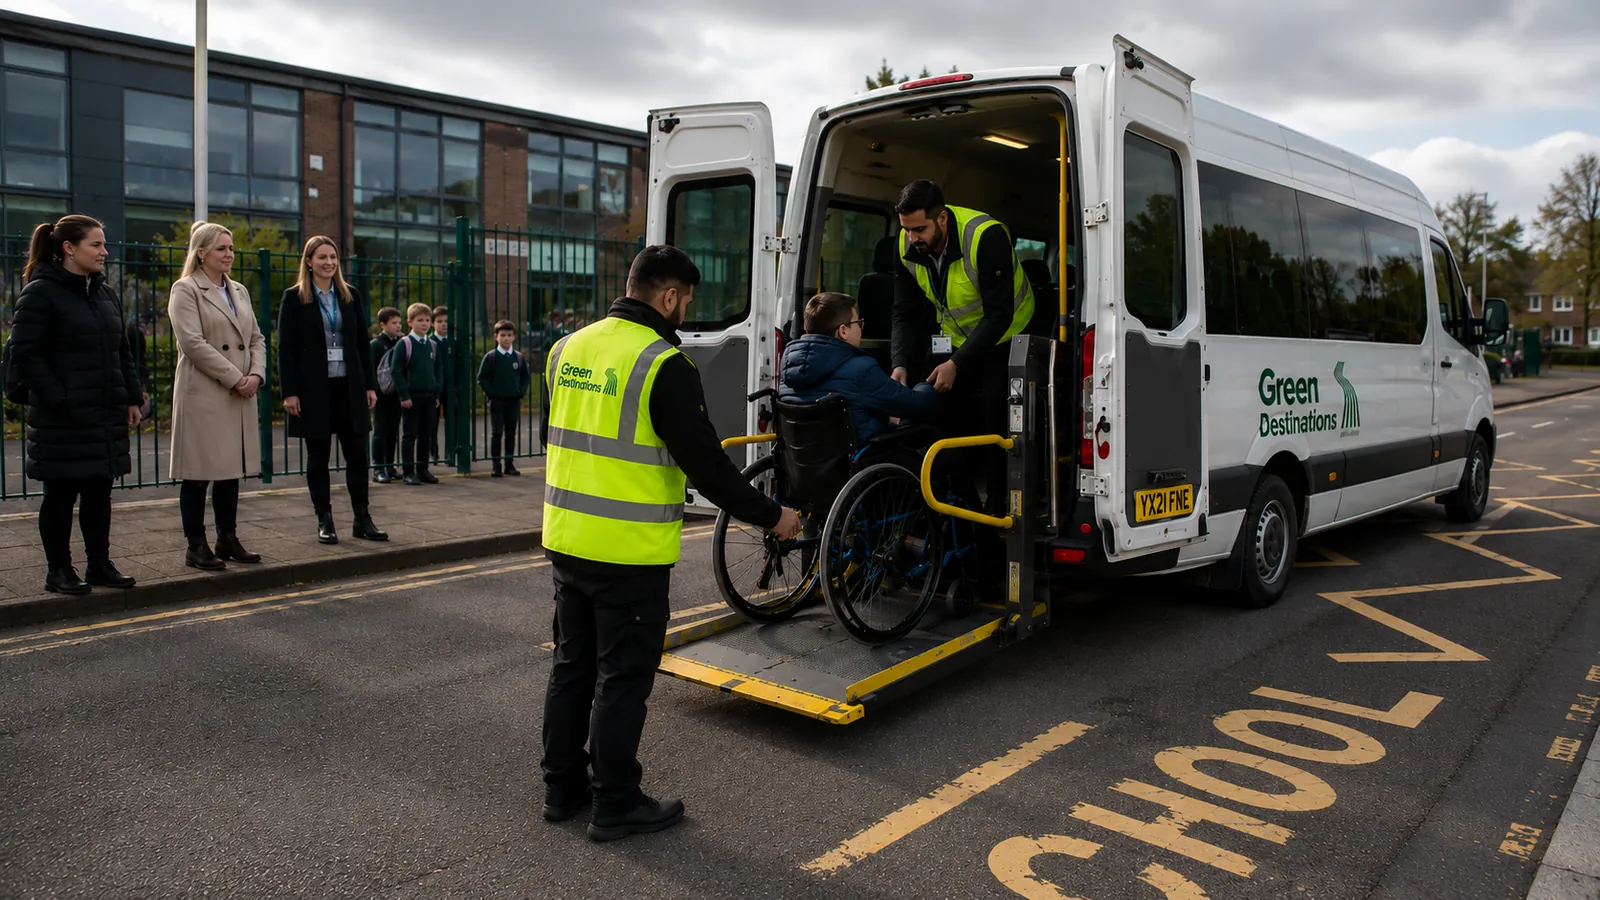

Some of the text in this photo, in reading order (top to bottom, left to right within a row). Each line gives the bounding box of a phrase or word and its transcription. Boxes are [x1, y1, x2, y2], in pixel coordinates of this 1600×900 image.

[561, 362, 593, 379] Green
[1258, 367, 1320, 406] Green
[1260, 409, 1337, 437] Destinations
[1140, 488, 1190, 517] YX21 FNE
